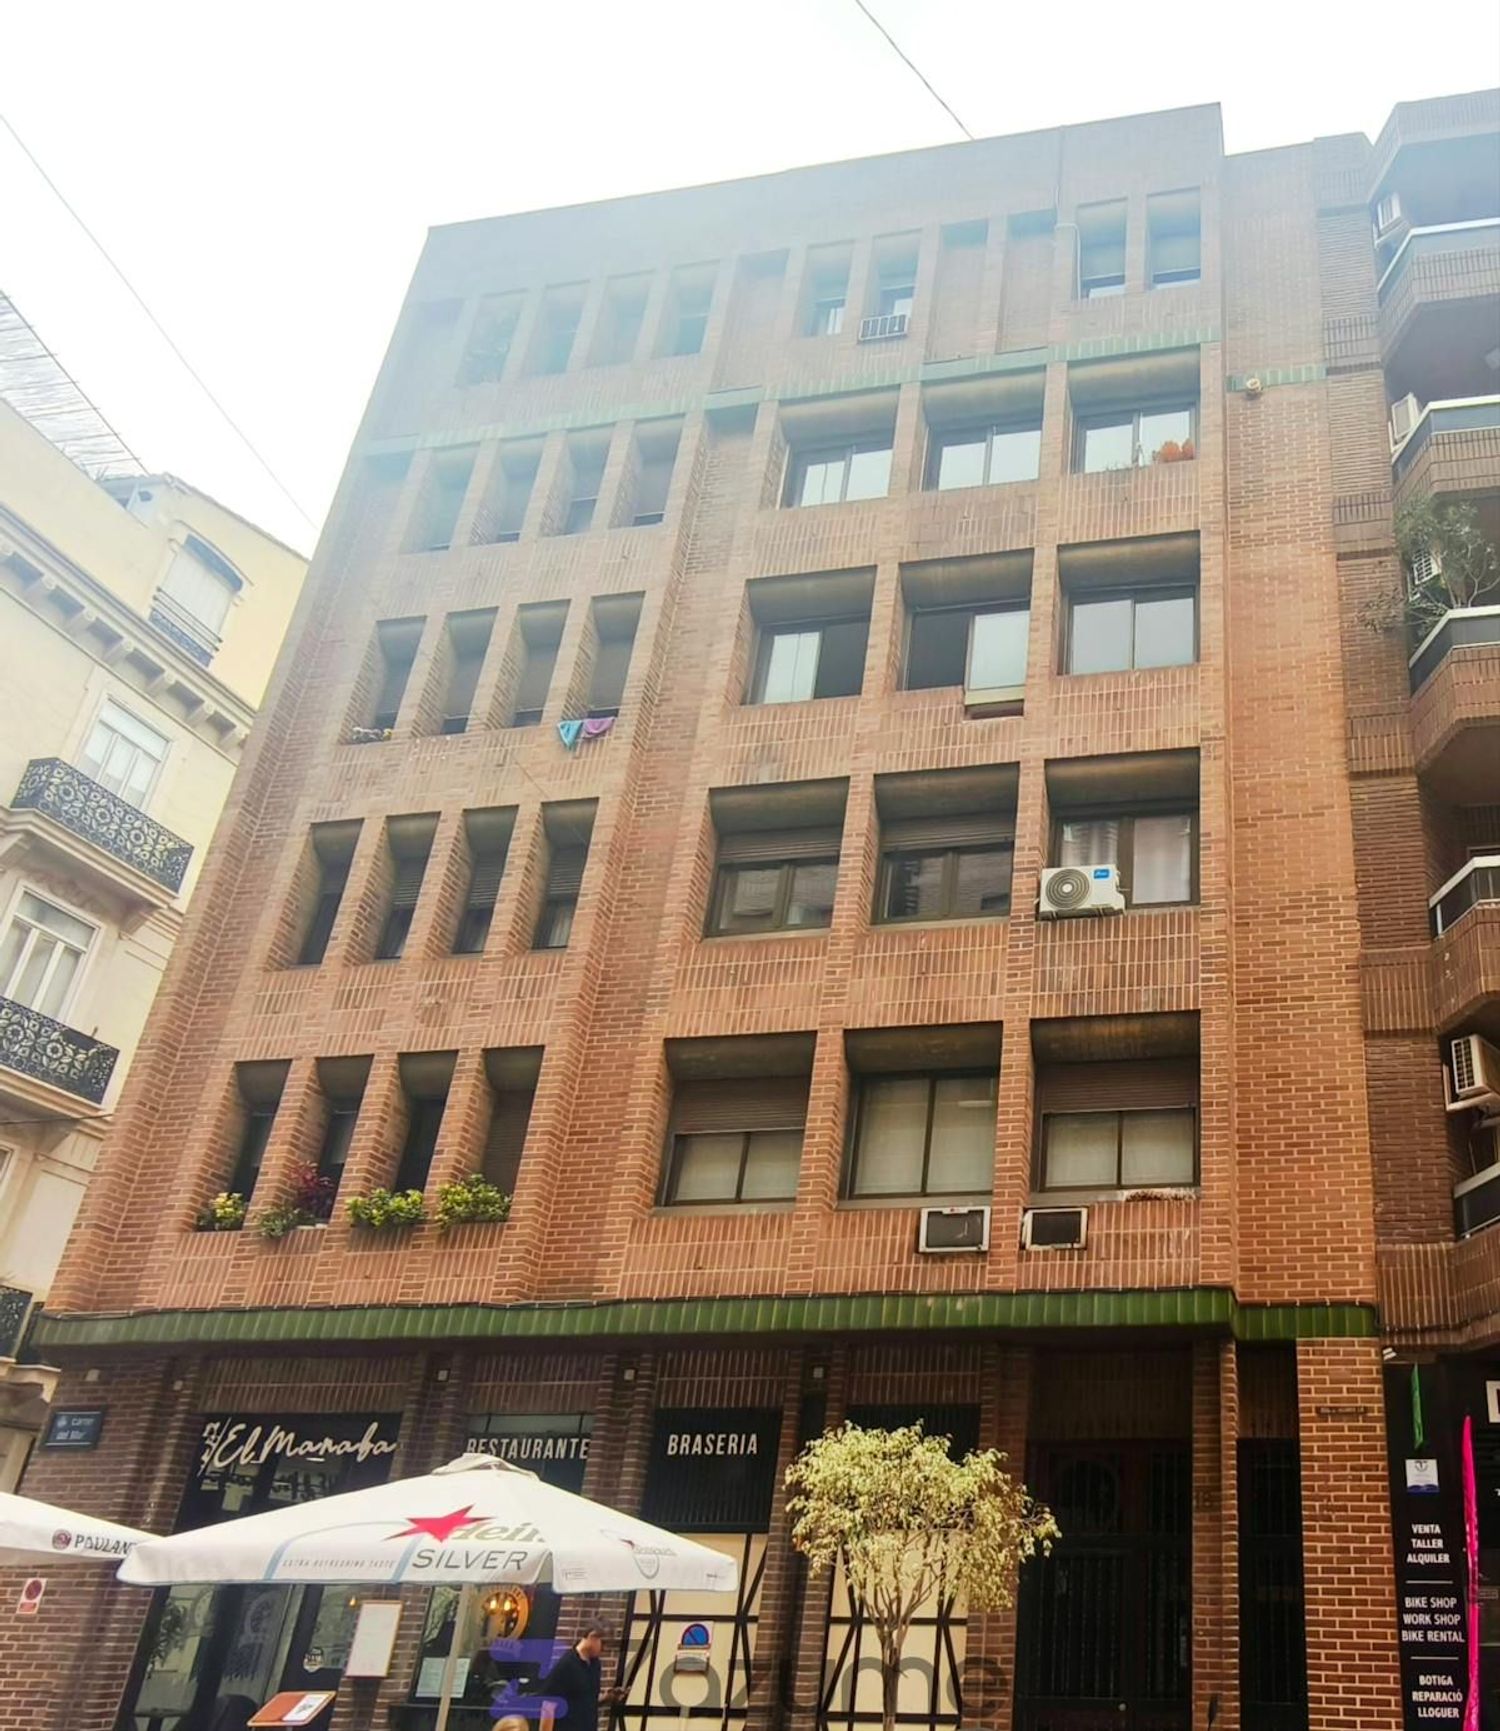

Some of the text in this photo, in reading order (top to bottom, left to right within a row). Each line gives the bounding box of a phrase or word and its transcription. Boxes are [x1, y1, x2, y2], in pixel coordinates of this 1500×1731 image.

[467, 1437, 590, 1460] RESTAURANTE
[667, 1433, 759, 1456] BRASERIA
[1411, 1523, 1442, 1534] VENTA
[1410, 1538, 1444, 1549] TALLER
[412, 1548, 529, 1571] SILVER
[1406, 1553, 1451, 1565] ALQUILER
[1404, 1596, 1458, 1609] BIKE SHOP
[1402, 1613, 1461, 1625] WORK SHOP
[1401, 1630, 1466, 1643] BIKE RENTAL
[1418, 1674, 1454, 1686] BOTIGA
[1411, 1689, 1464, 1702] REPARACIÓ
[1417, 1706, 1460, 1718] LLOGUER
